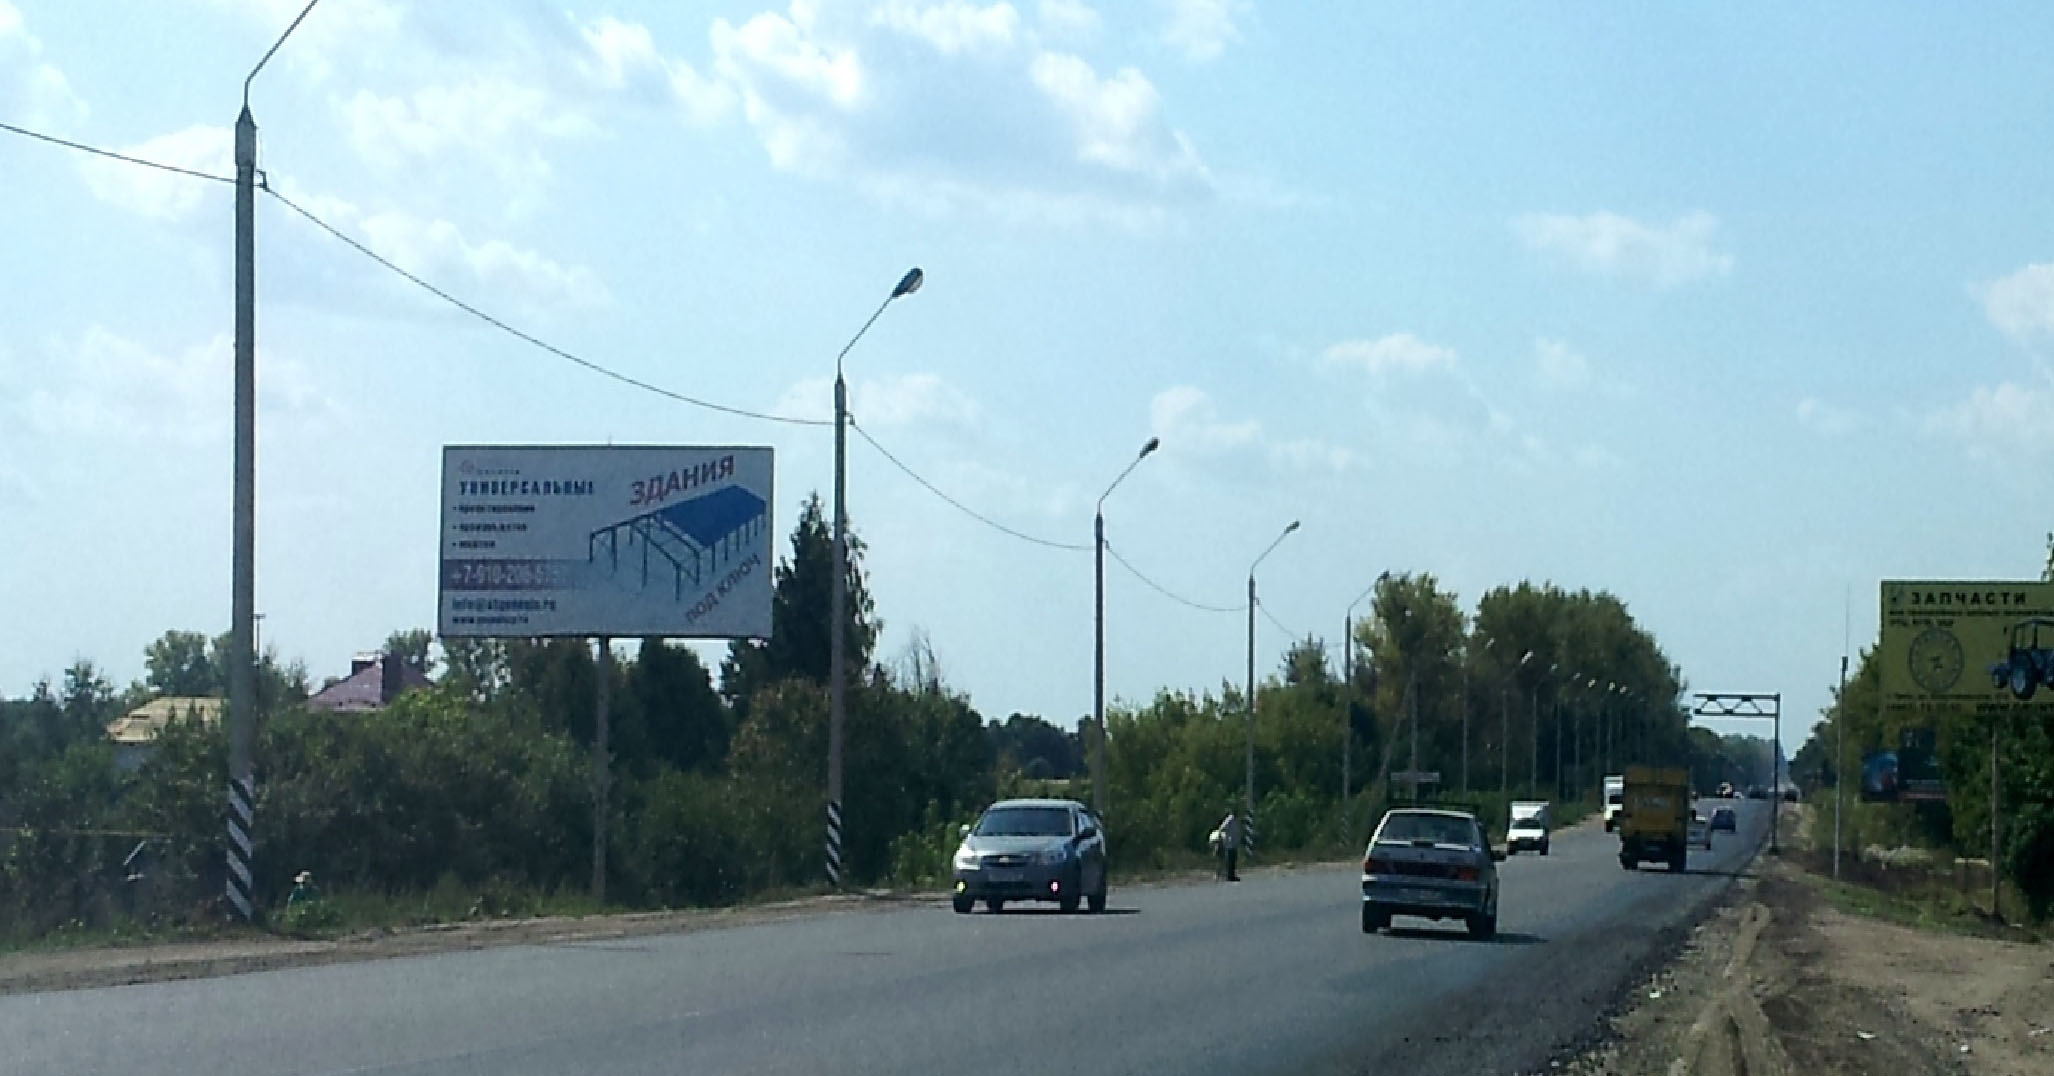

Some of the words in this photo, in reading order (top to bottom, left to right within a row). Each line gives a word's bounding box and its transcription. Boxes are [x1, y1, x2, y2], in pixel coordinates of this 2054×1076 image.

[630, 455, 734, 505] ЗДАНИЯ
[686, 591, 720, 624] ПОД
[718, 552, 761, 598] КЛЮЧ
[1911, 591, 2027, 605] ЗАПЧАСТИ
